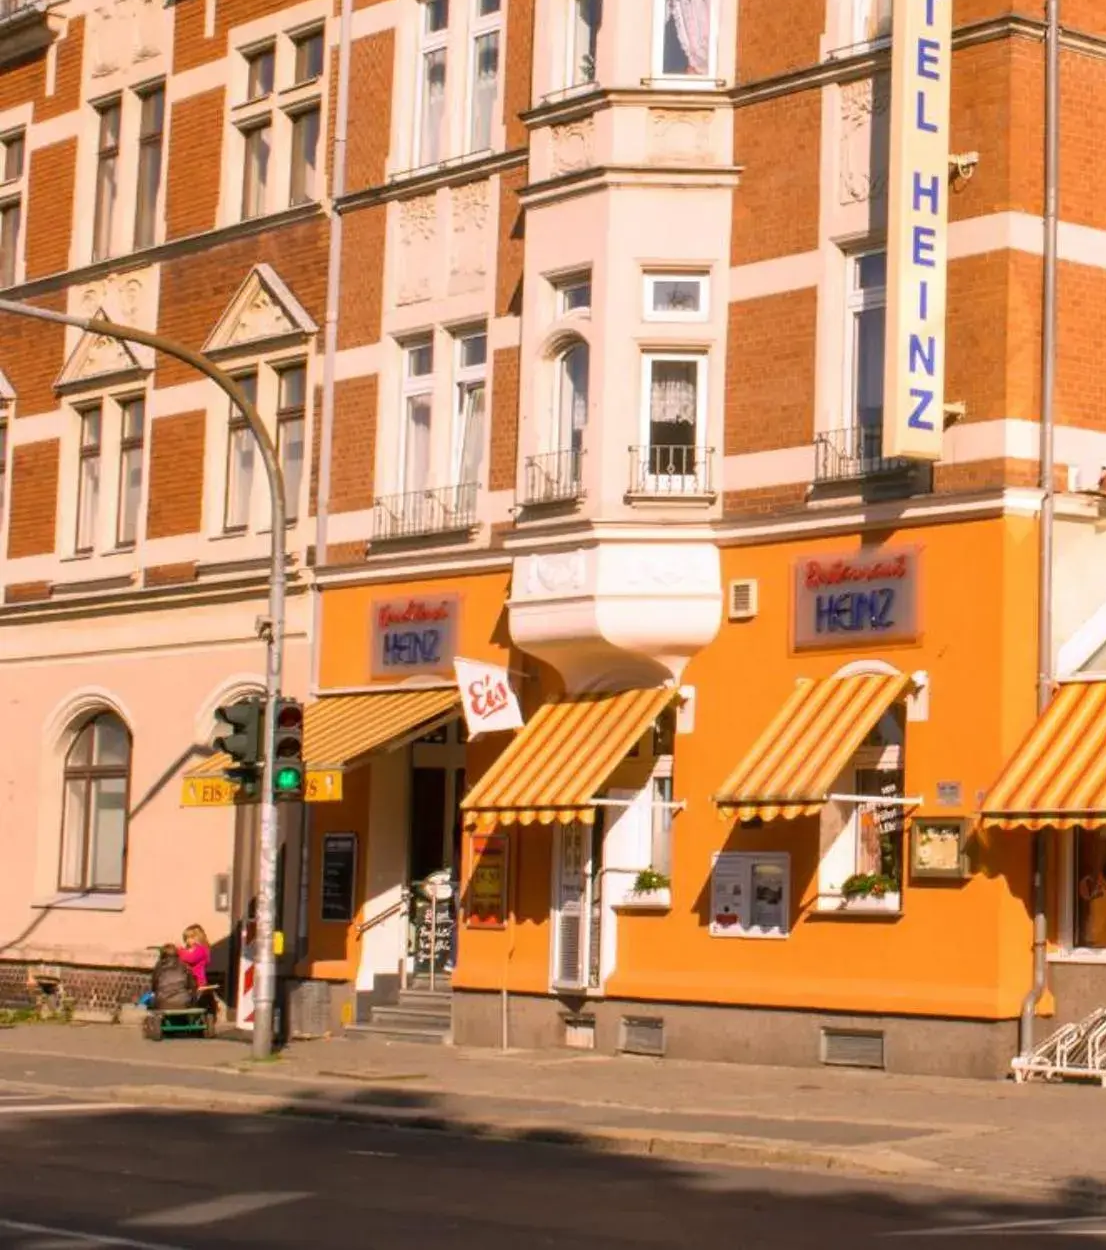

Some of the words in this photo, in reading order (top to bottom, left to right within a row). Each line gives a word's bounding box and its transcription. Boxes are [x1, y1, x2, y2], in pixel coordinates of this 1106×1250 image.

[907, 171, 939, 431] HEINZ
[815, 588, 895, 633] HEINZ
[383, 629, 441, 666] HEINZ
[468, 674, 508, 718] Eis
